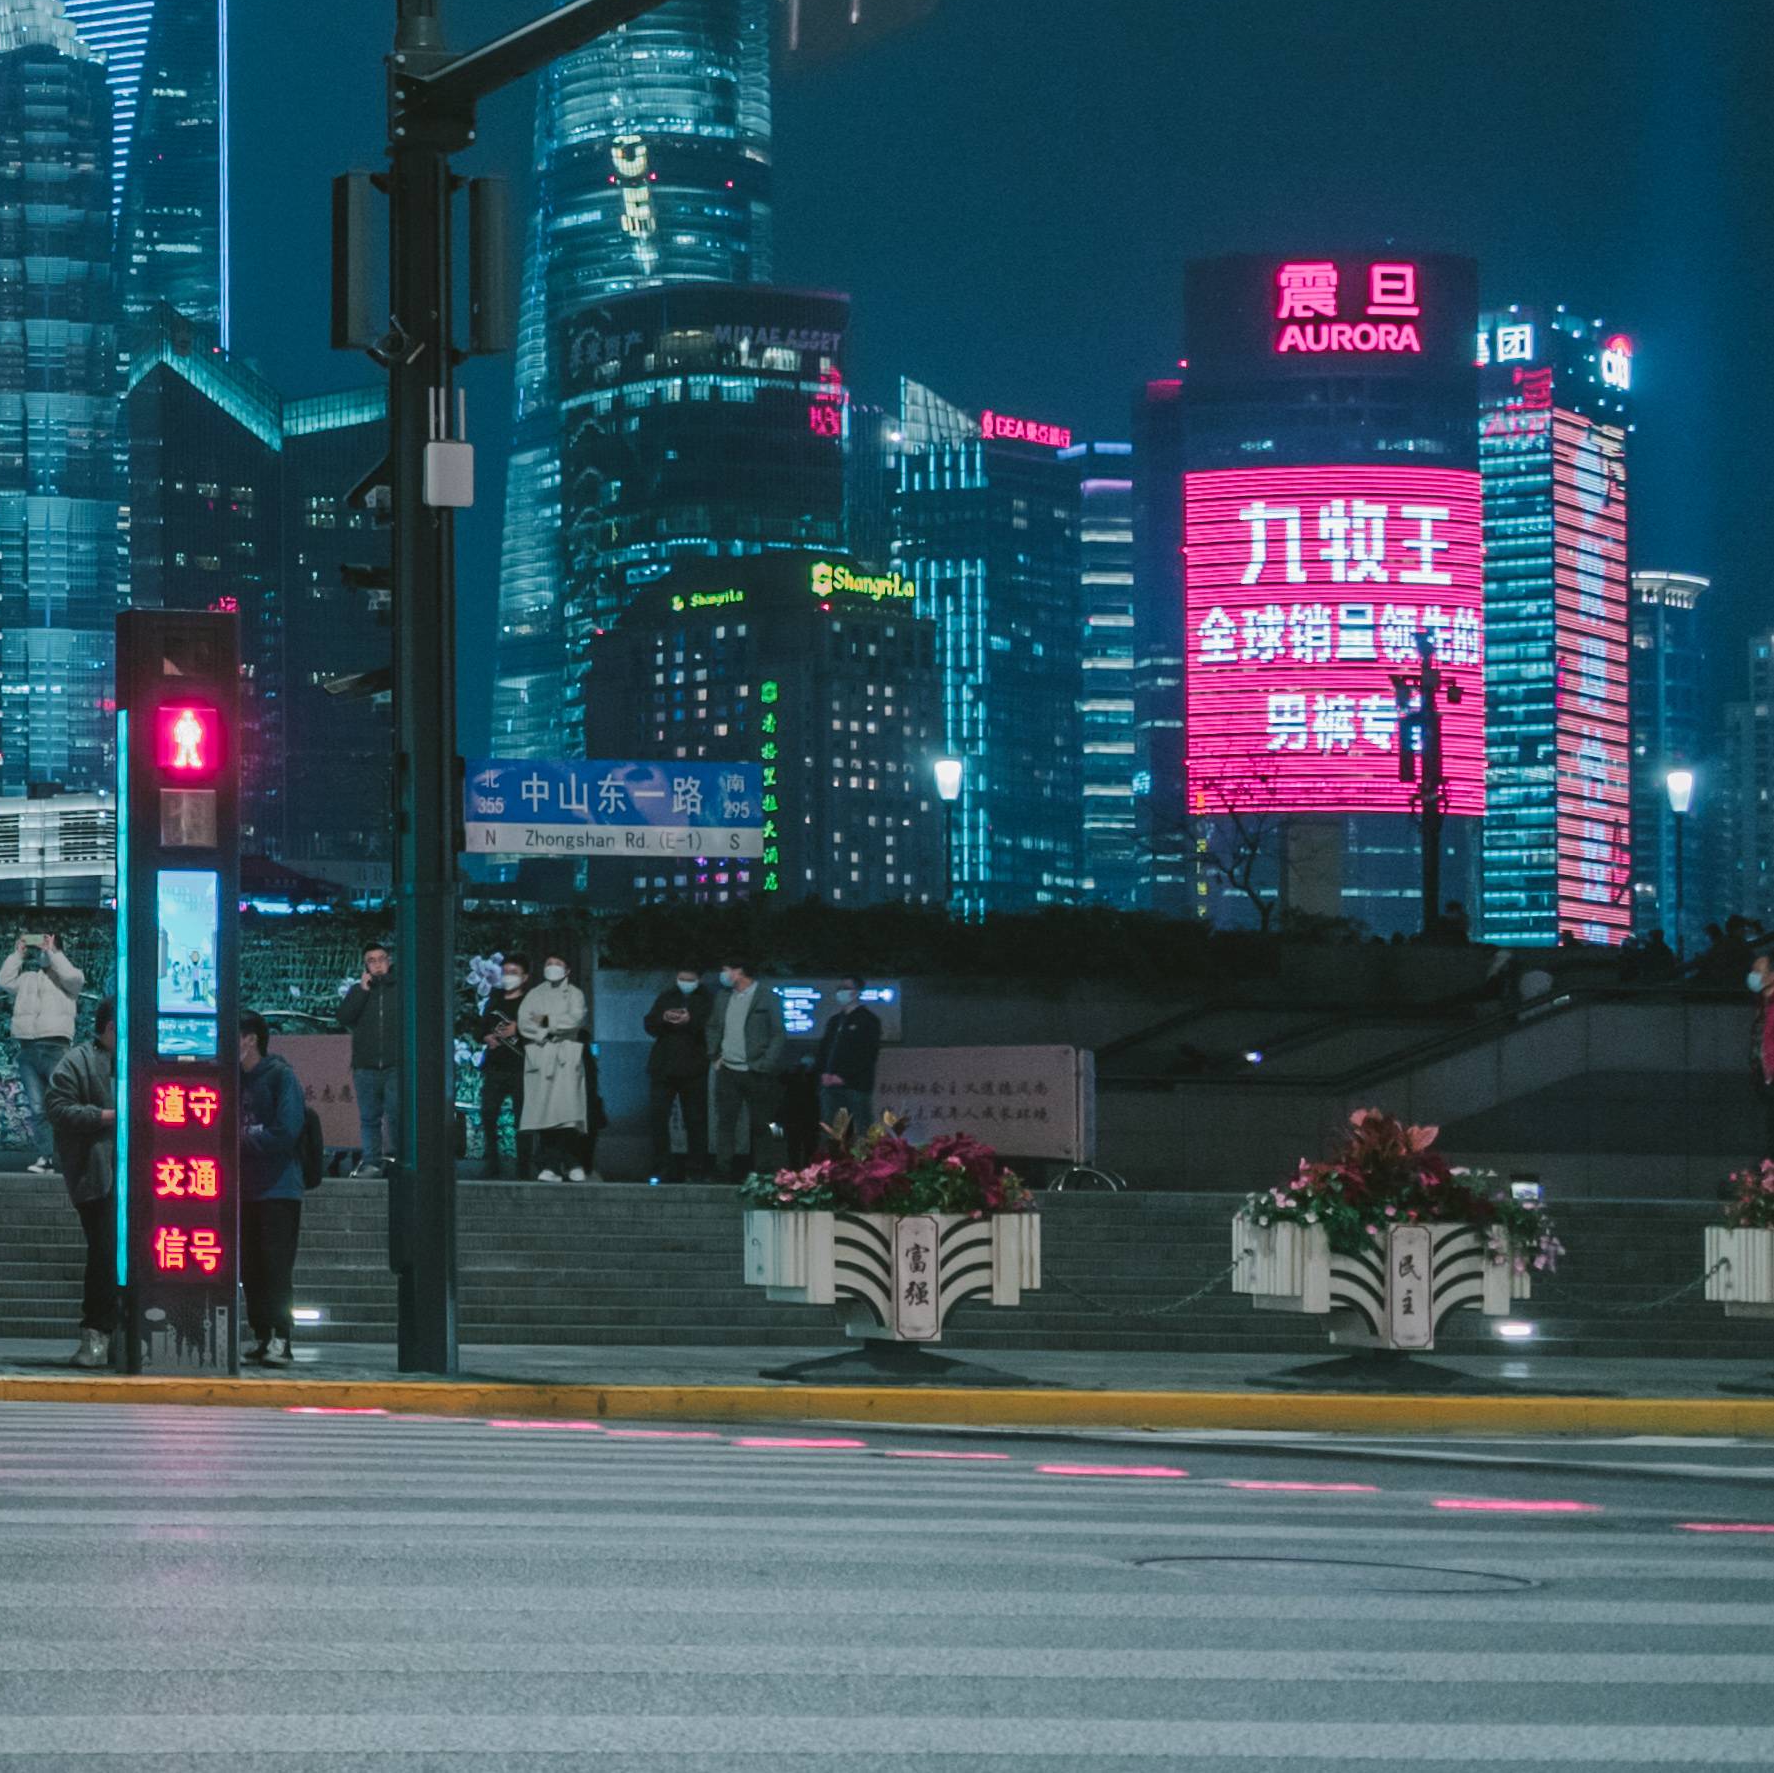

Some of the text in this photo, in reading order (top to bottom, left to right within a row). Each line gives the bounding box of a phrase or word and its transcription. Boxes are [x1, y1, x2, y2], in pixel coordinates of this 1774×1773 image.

[1277, 262, 1421, 318] 震旦
[715, 324, 842, 352] MIRAE ASSET
[1277, 322, 1422, 353] AURORA
[1238, 499, 1453, 585] 九牧王
[480, 768, 501, 789] 北
[521, 772, 703, 815] 中山东一路
[726, 773, 746, 794] 南
[478, 796, 505, 814] 355
[723, 801, 750, 820] 295
[486, 829, 740, 852] N Zhongshan Rd. (E-1) S
[154, 1085, 218, 1124] 遵守
[156, 1156, 218, 1197] 交通
[155, 1226, 222, 1271] 信号
[904, 1243, 931, 1306] 富强
[1398, 1254, 1422, 1315] 民主
